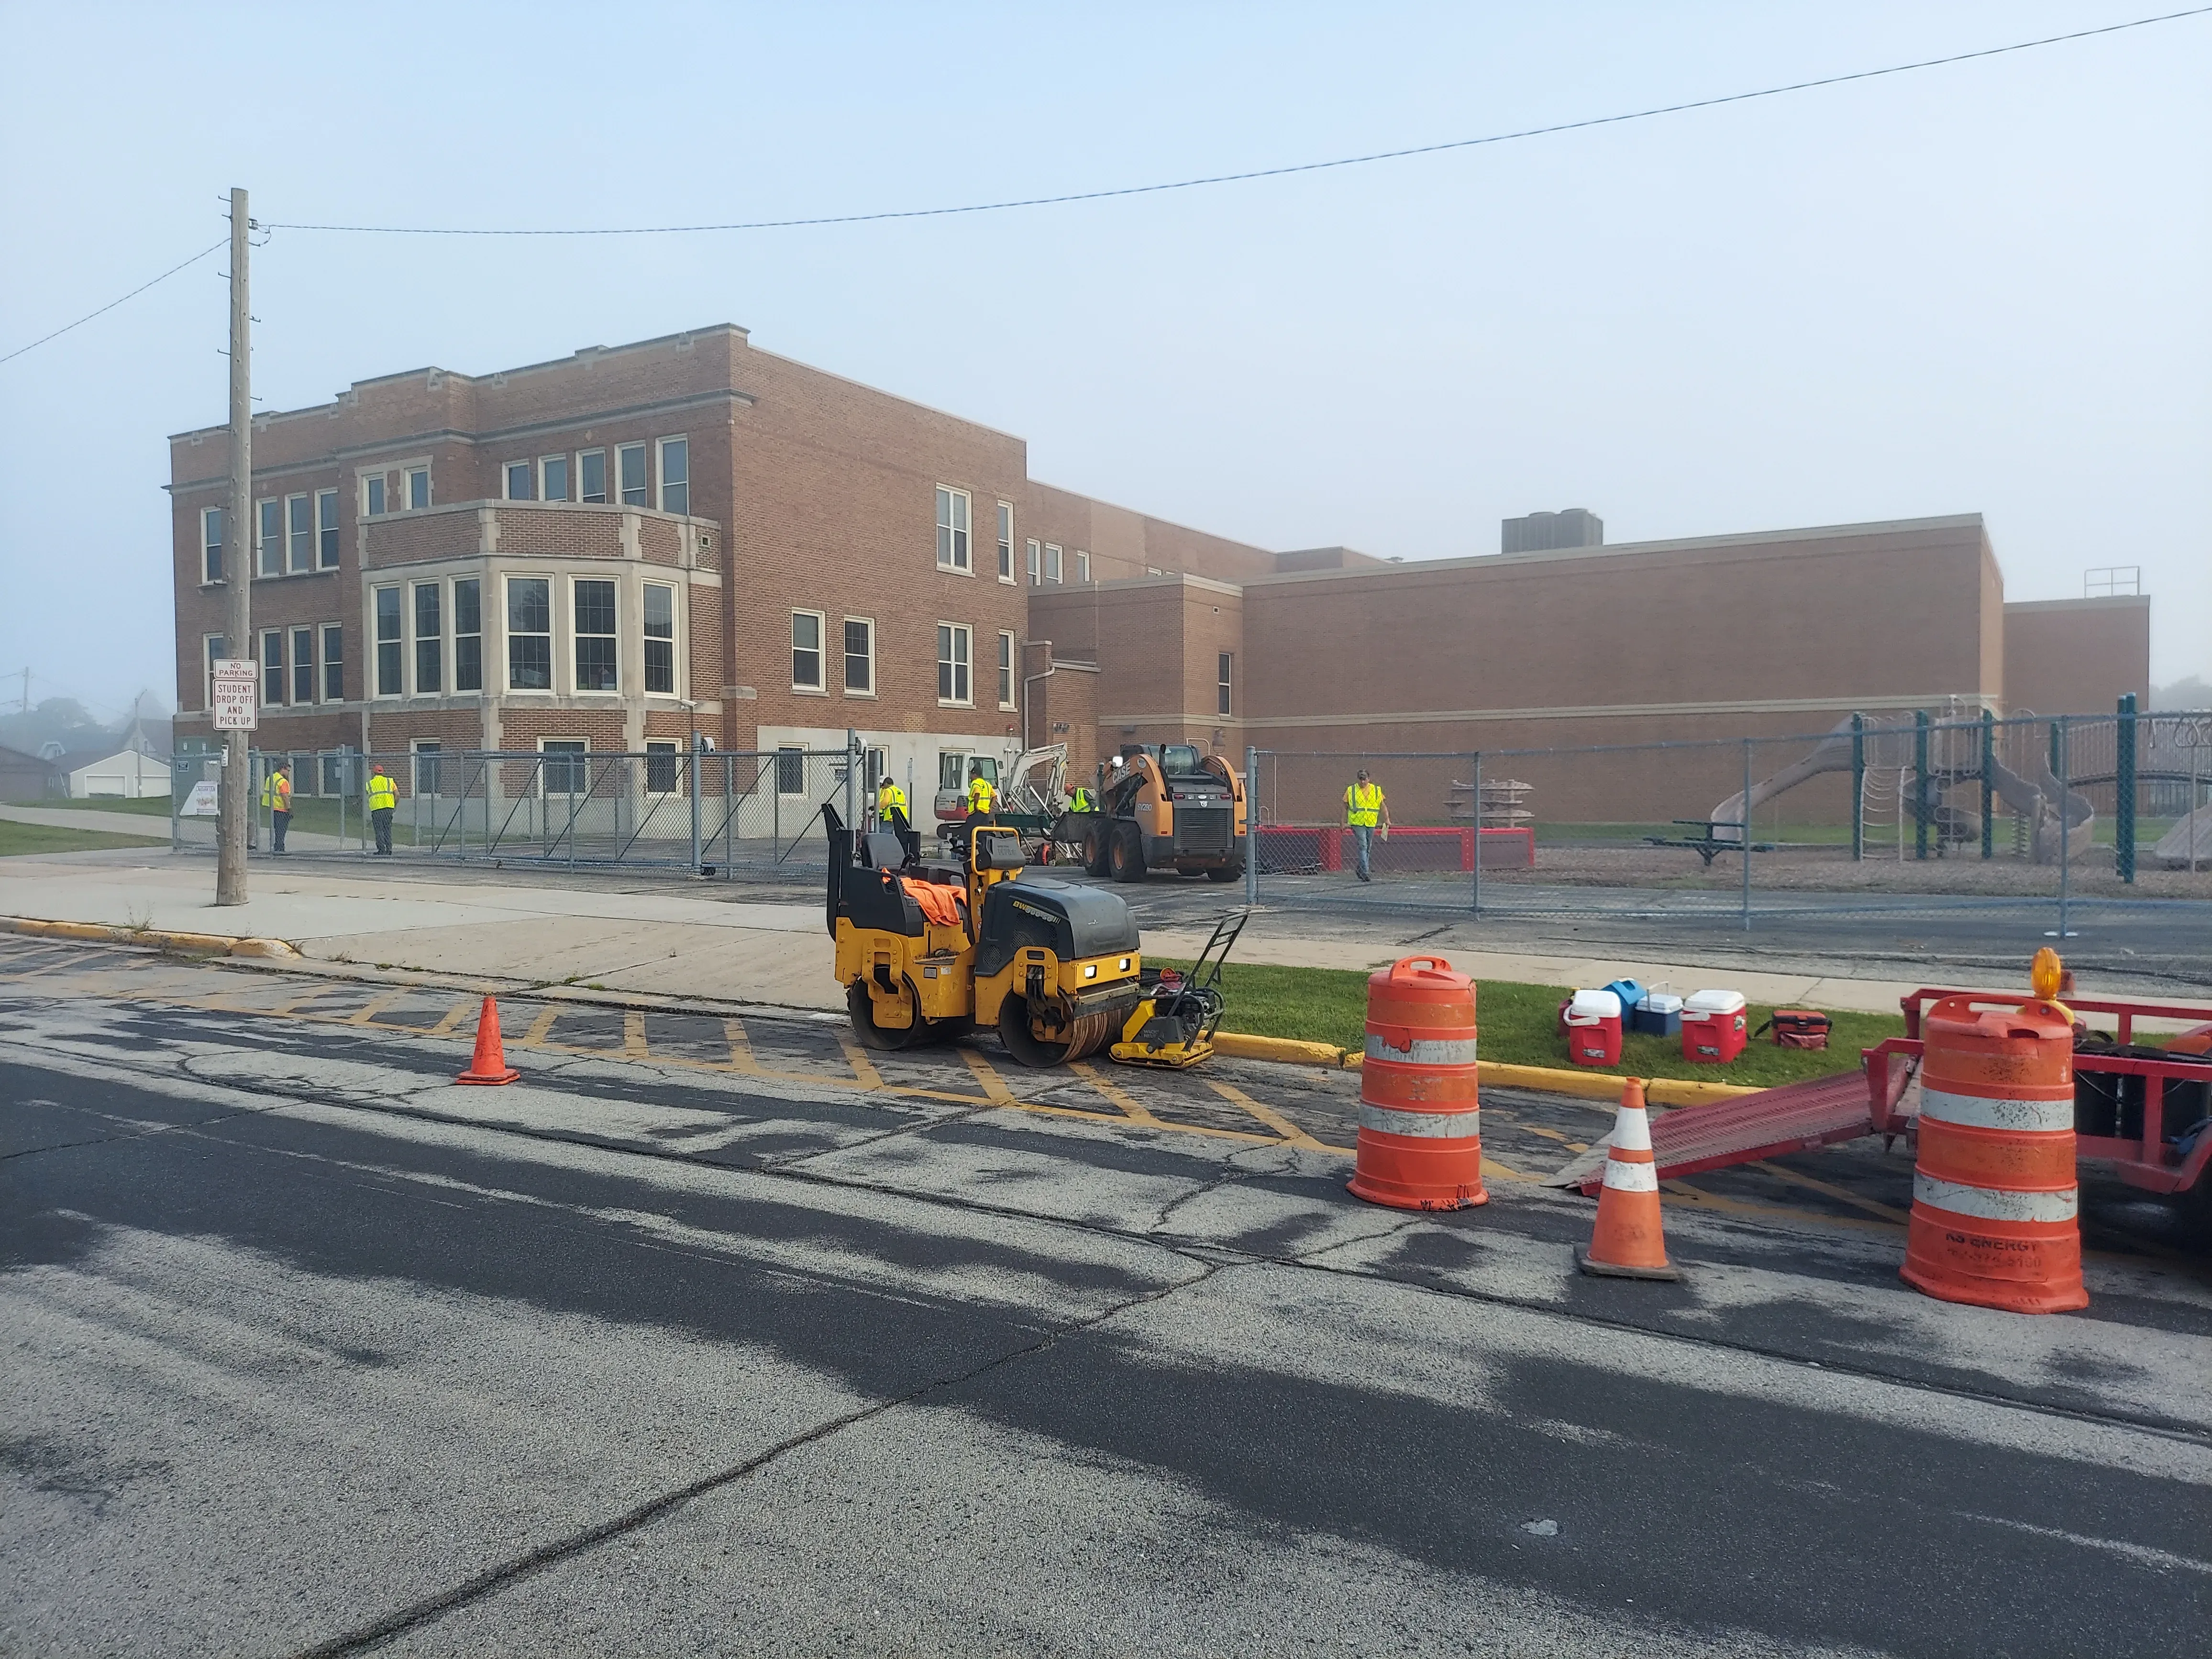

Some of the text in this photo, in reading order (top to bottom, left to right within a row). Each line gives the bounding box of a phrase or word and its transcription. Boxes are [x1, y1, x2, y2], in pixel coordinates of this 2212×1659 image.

[218, 685, 251, 693] STUDENT
[217, 695, 254, 704] DROP OFF
[227, 706, 243, 714] AND
[220, 716, 237, 725] PICK
[1112, 762, 1130, 784] CASE
